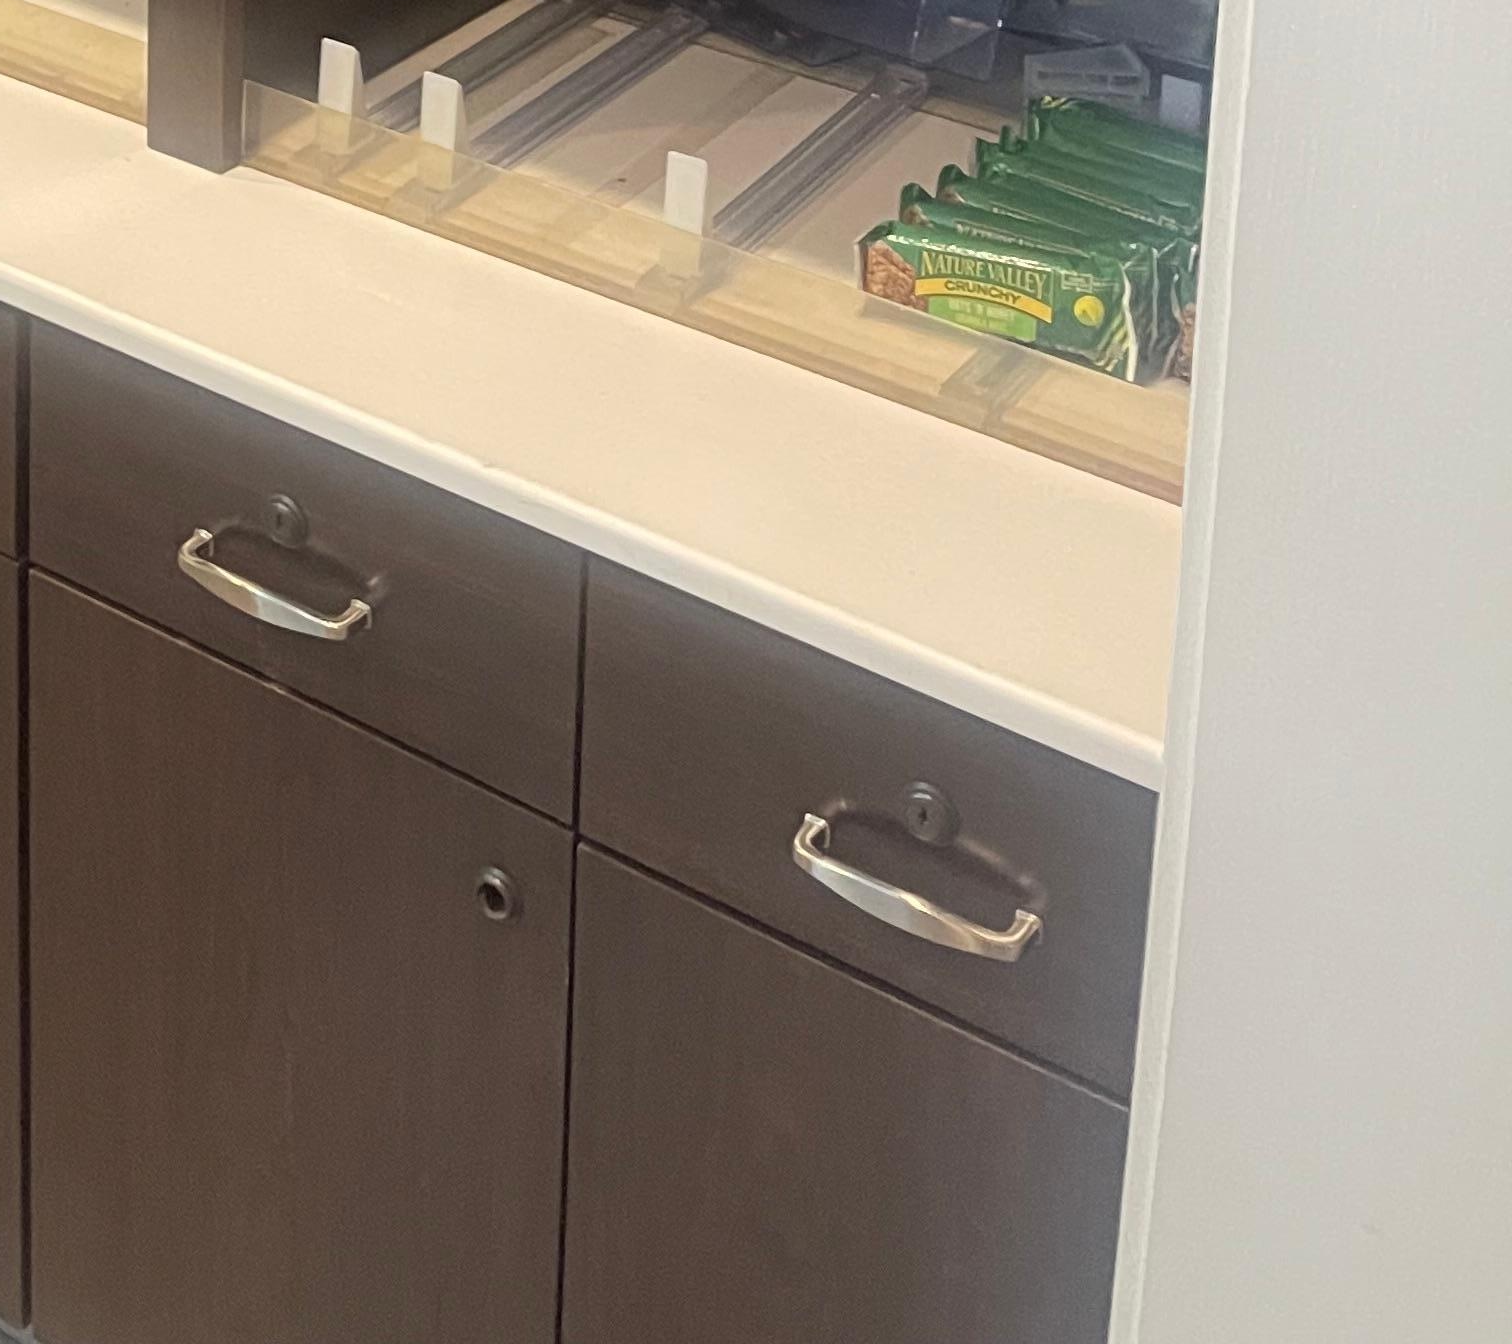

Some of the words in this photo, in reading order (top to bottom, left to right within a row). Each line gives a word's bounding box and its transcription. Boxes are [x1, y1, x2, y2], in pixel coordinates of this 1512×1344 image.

[920, 250, 985, 277] NATURE
[986, 262, 1048, 300] VALLEY
[943, 279, 1021, 305] CRUNCHY
